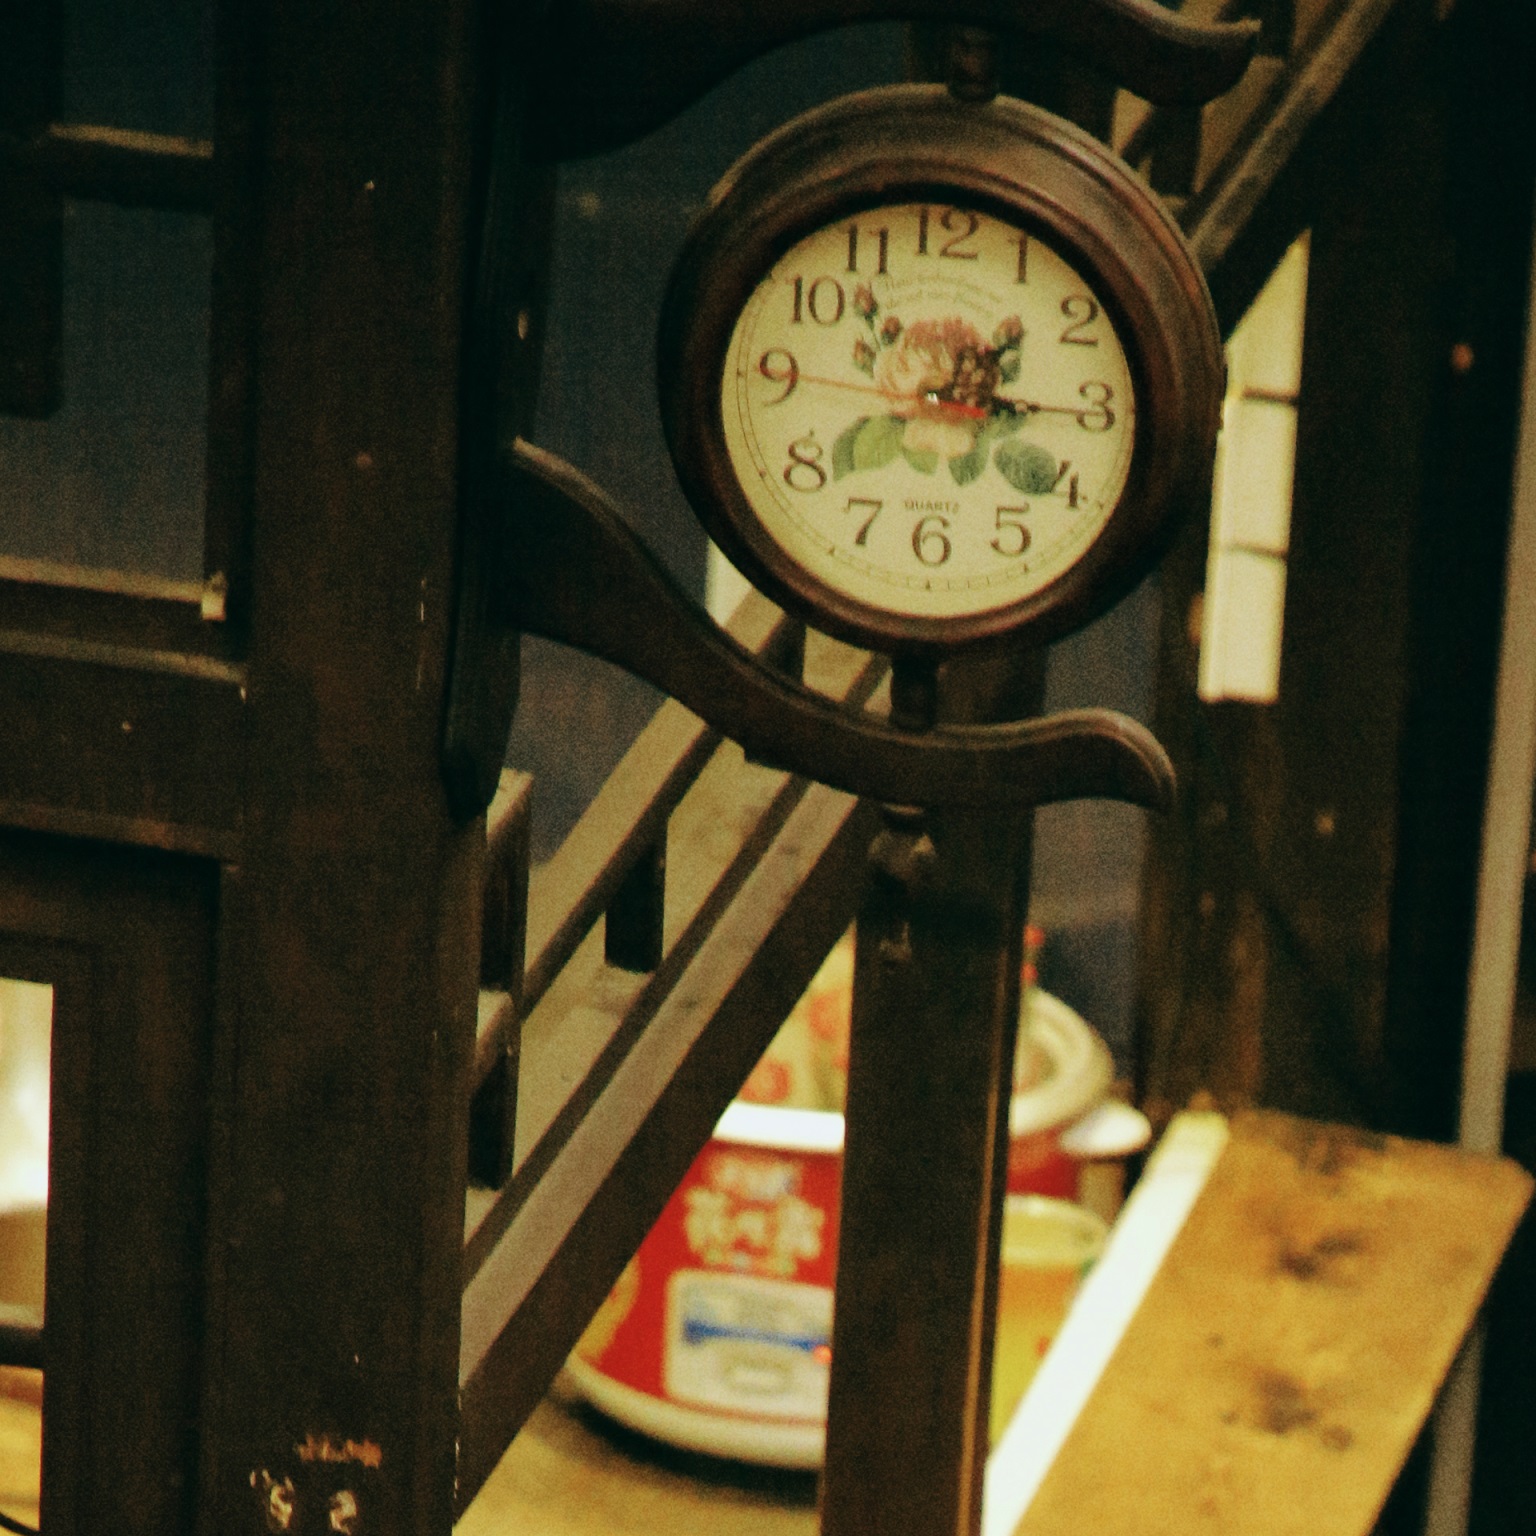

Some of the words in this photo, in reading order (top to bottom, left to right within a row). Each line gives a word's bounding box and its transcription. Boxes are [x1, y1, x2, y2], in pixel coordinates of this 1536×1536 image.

[842, 223, 890, 275] 11
[913, 206, 980, 261] 12
[1006, 232, 1029, 285] 1
[786, 274, 847, 328] 10
[1059, 293, 1099, 348] 2
[758, 347, 800, 404] 9
[1075, 380, 1116, 434] 3
[783, 436, 828, 494] 8
[1050, 459, 1088, 509] 4
[842, 496, 883, 547] 7
[911, 514, 952, 568] 6
[990, 501, 1032, 557] 5
